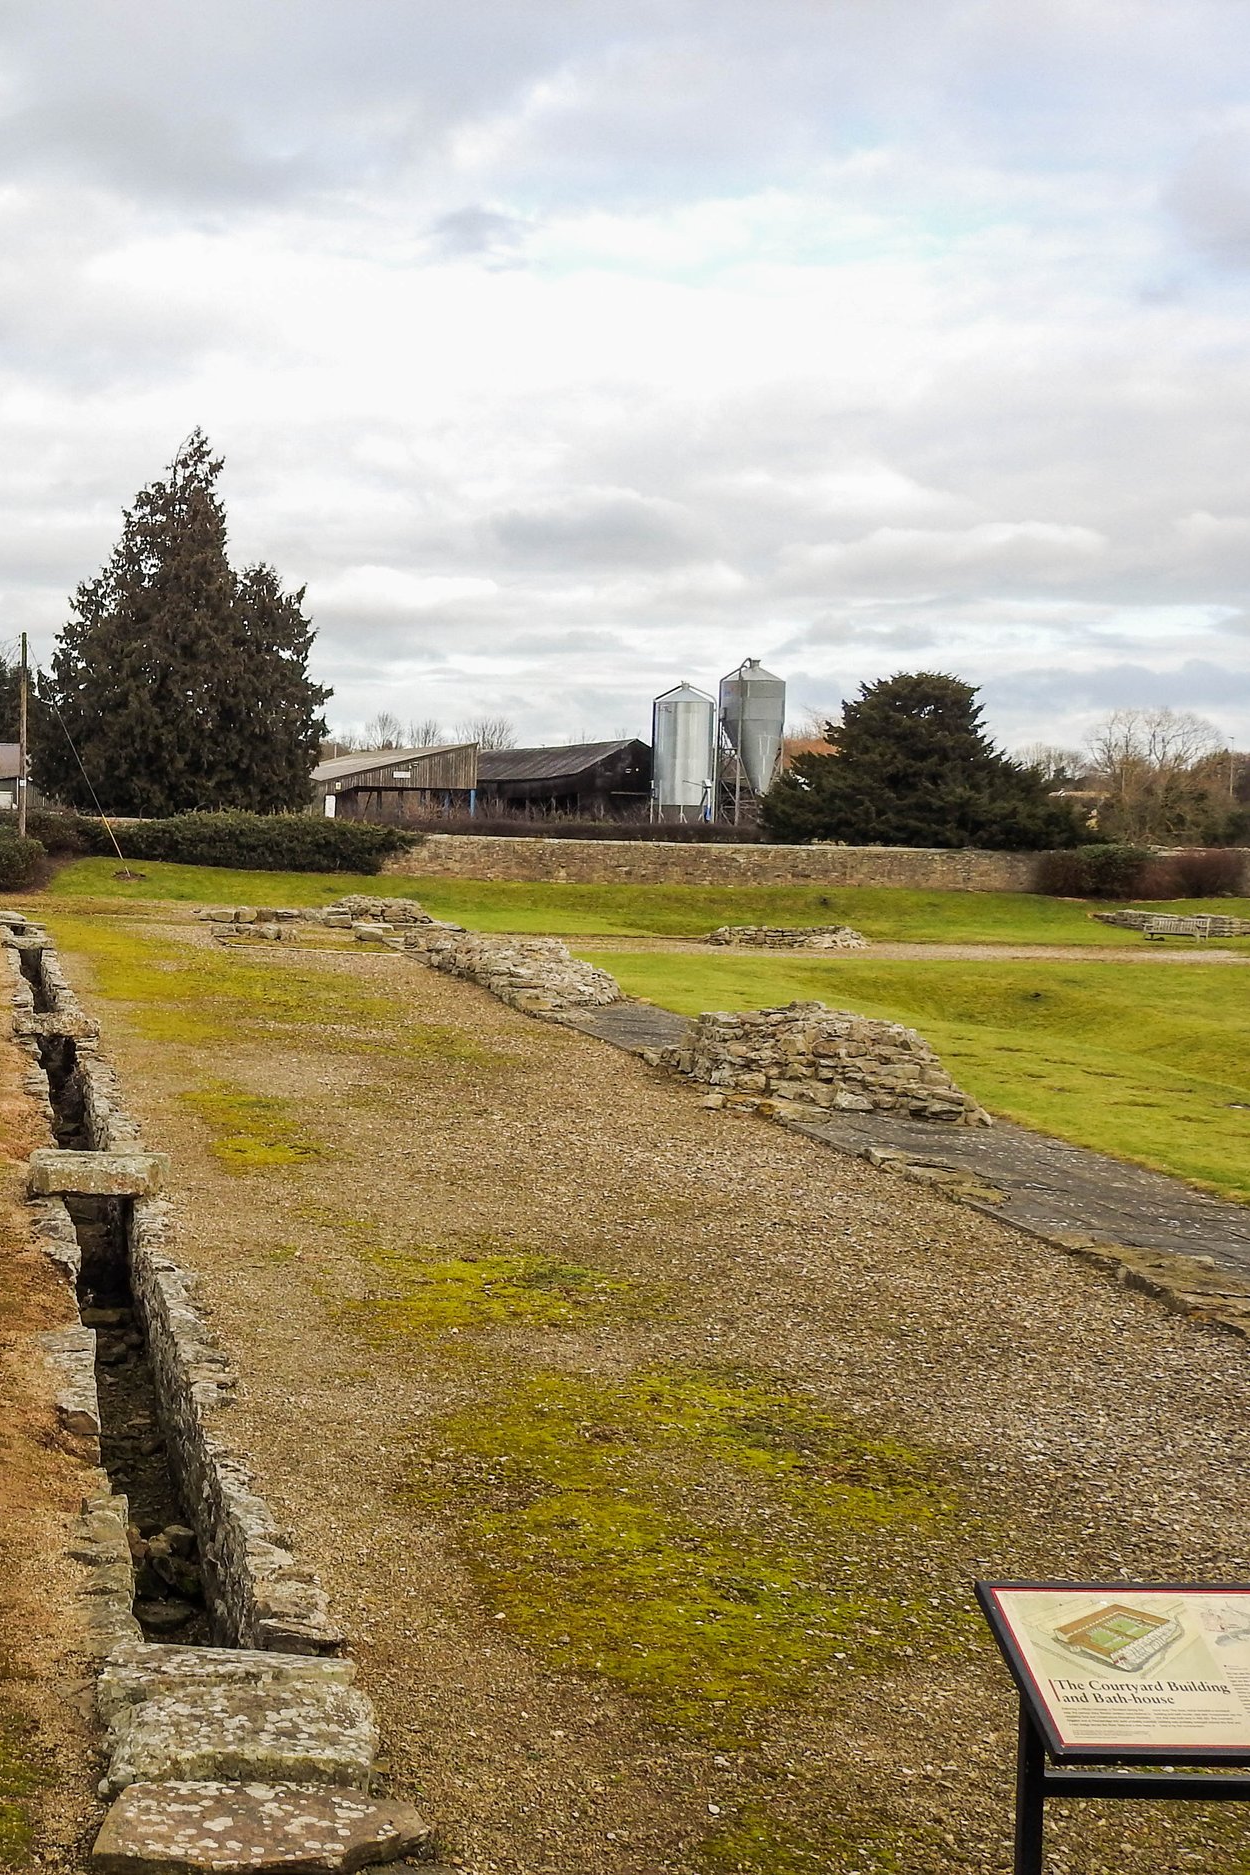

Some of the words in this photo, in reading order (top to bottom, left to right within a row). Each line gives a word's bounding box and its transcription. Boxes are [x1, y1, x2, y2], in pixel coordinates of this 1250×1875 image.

[1054, 1679, 1085, 1691] The
[1088, 1680, 1163, 1694] Courtyard
[1166, 1681, 1231, 1695] Building
[1062, 1692, 1089, 1703] and
[1094, 1693, 1175, 1705] Bath-house
